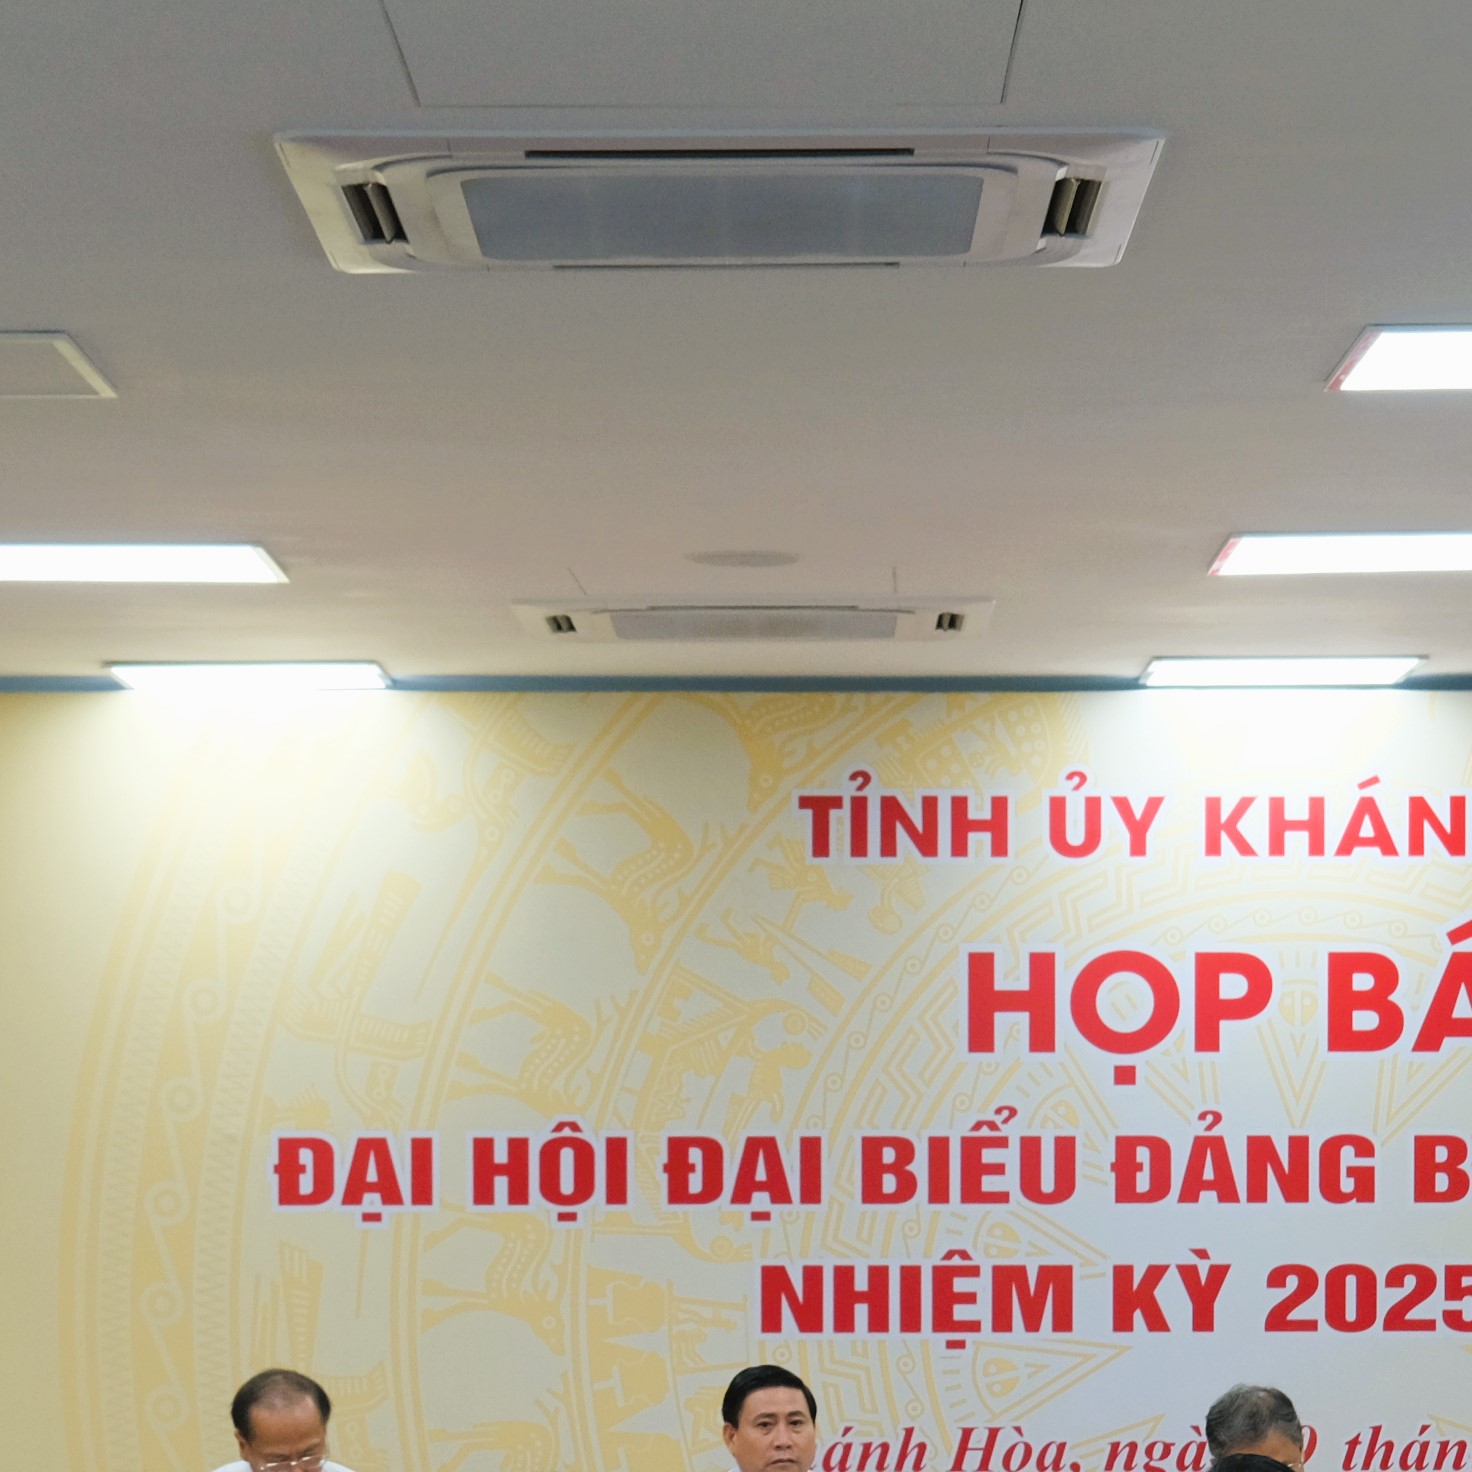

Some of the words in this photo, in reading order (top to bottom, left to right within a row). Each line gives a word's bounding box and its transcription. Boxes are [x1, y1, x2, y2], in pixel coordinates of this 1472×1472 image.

[799, 771, 1009, 858] TỈNH
[1049, 770, 1164, 859] ỦY
[968, 949, 1274, 1086] HỌP
[274, 1137, 433, 1222] ĐẠI
[473, 1121, 628, 1222] HỘI
[663, 1136, 822, 1221] ĐẠI
[861, 1104, 1077, 1205] BIỂU
[1111, 1110, 1376, 1204] ĐẢNG
[761, 1249, 1074, 1350] NHIỆM
[1113, 1247, 1231, 1333] KỲ
